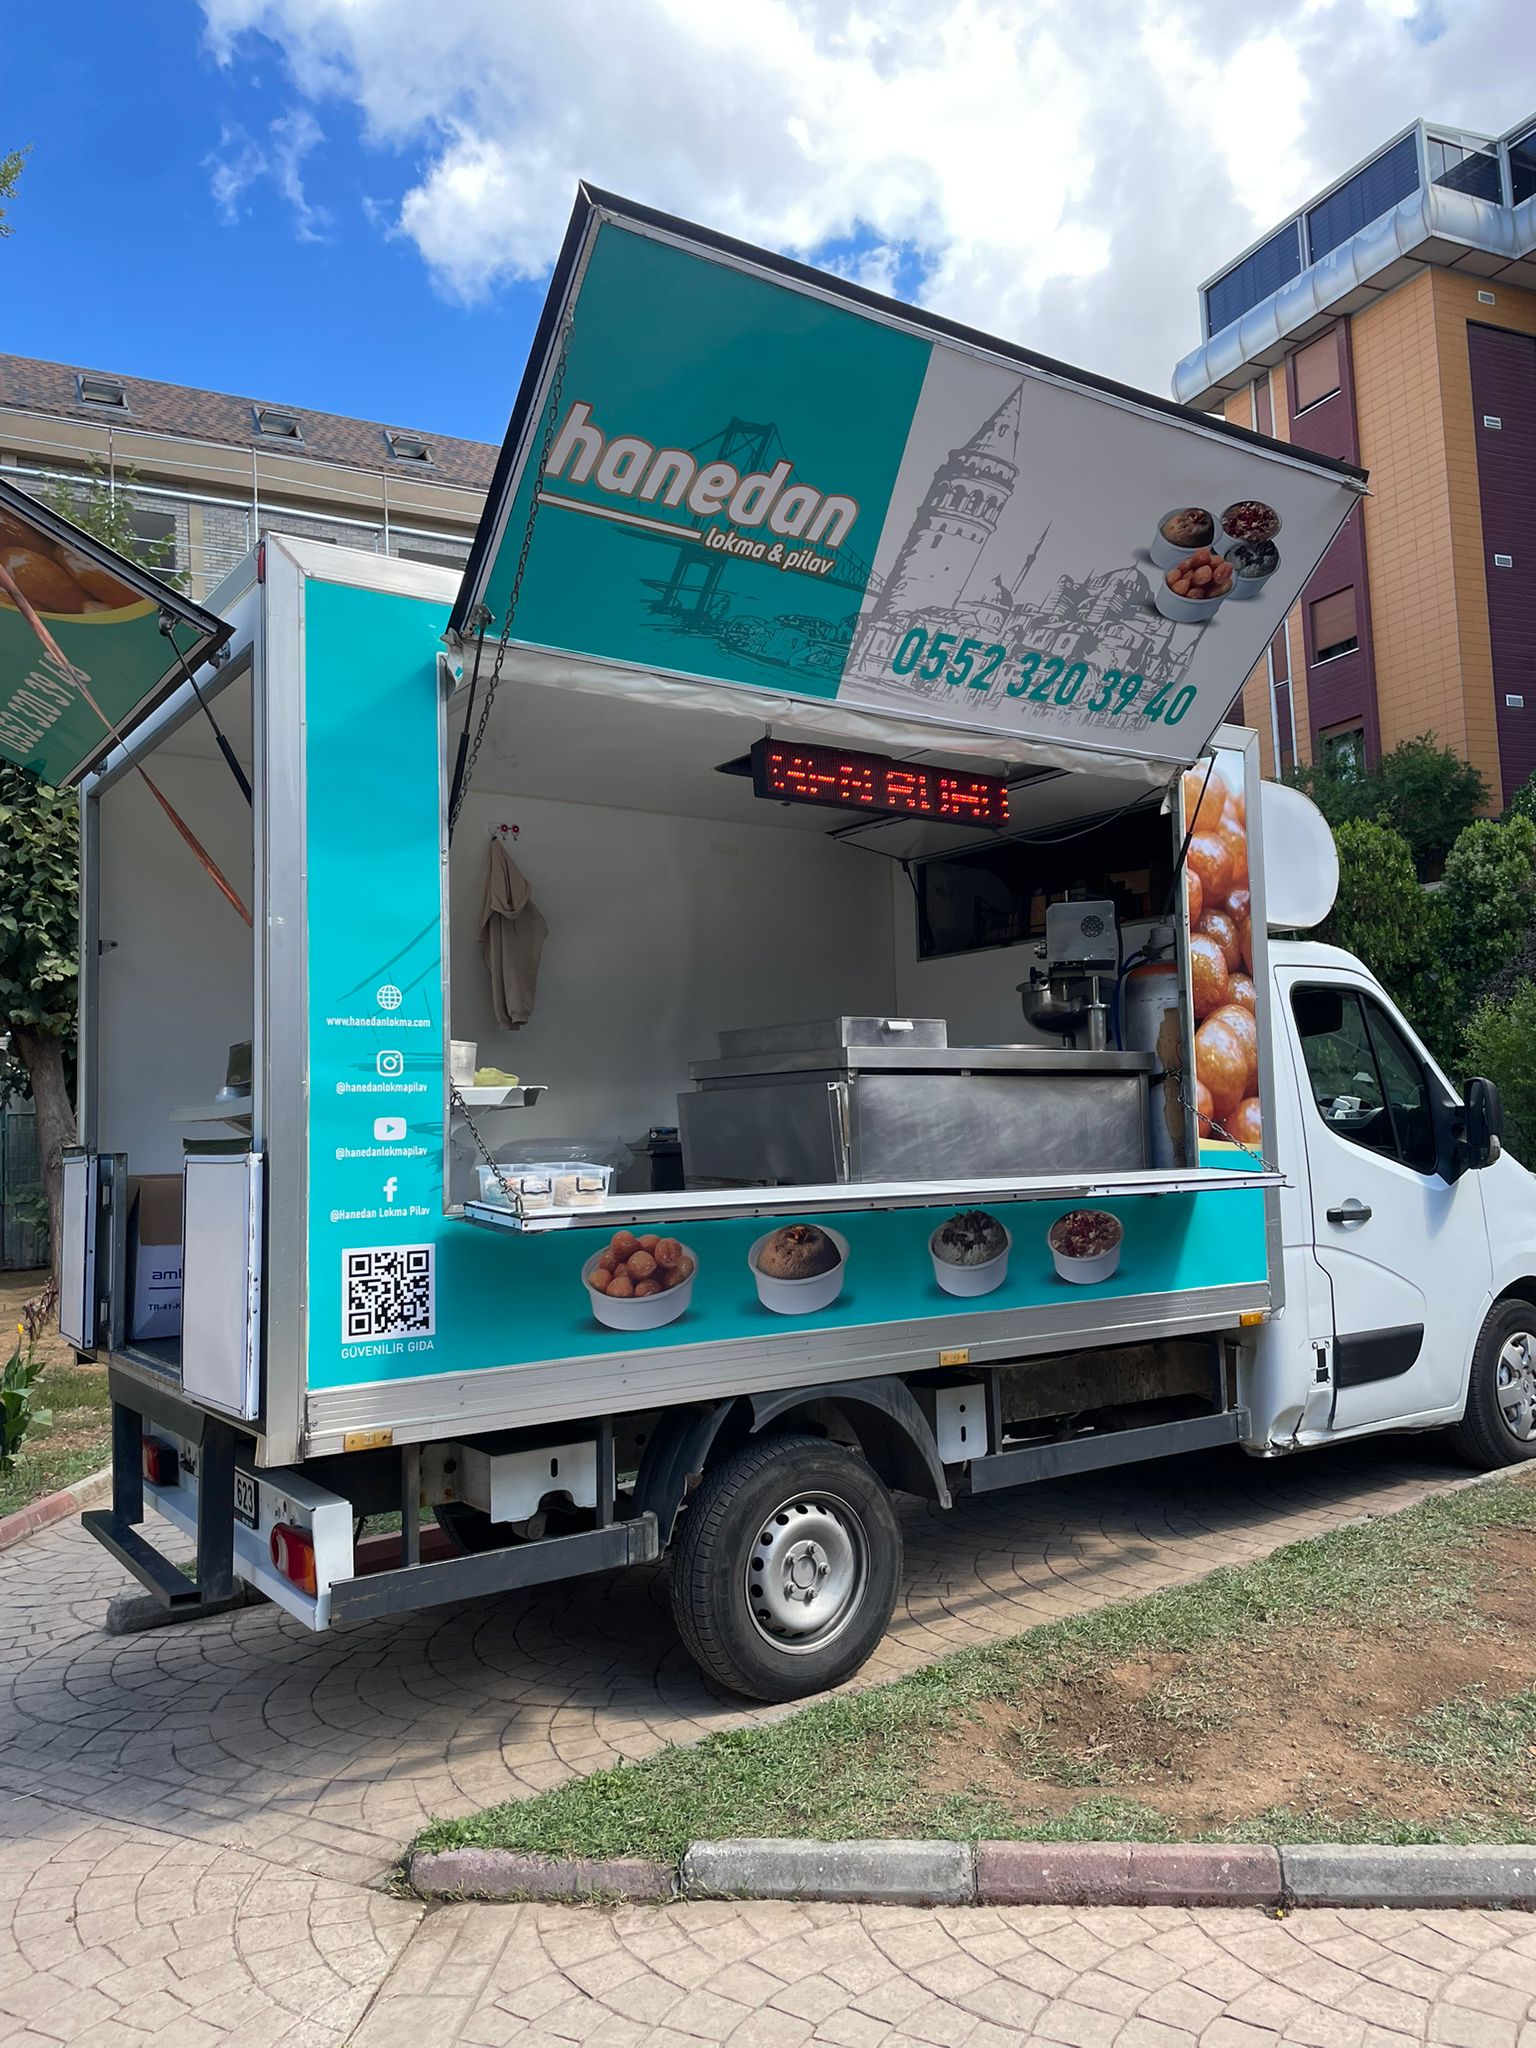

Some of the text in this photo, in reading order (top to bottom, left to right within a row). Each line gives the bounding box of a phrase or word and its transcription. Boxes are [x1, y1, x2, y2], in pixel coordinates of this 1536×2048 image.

[543, 400, 859, 550] hanedan
[703, 526, 835, 576] lokma & pilav
[24, 671, 75, 707] 39
[892, 627, 1198, 726] 0552 320 39 40
[8, 688, 62, 728] 320
[326, 1015, 431, 1027] www.hanedanlokma.com
[336, 1081, 427, 1095] @hanedanlokmapilav
[336, 1145, 427, 1160] @hanedanlokmapilav
[330, 1205, 431, 1223] @Hanedan Lokma Pilav
[341, 1340, 435, 1359] GÜVENİLİR GIDA
[237, 1478, 253, 1514] 623
